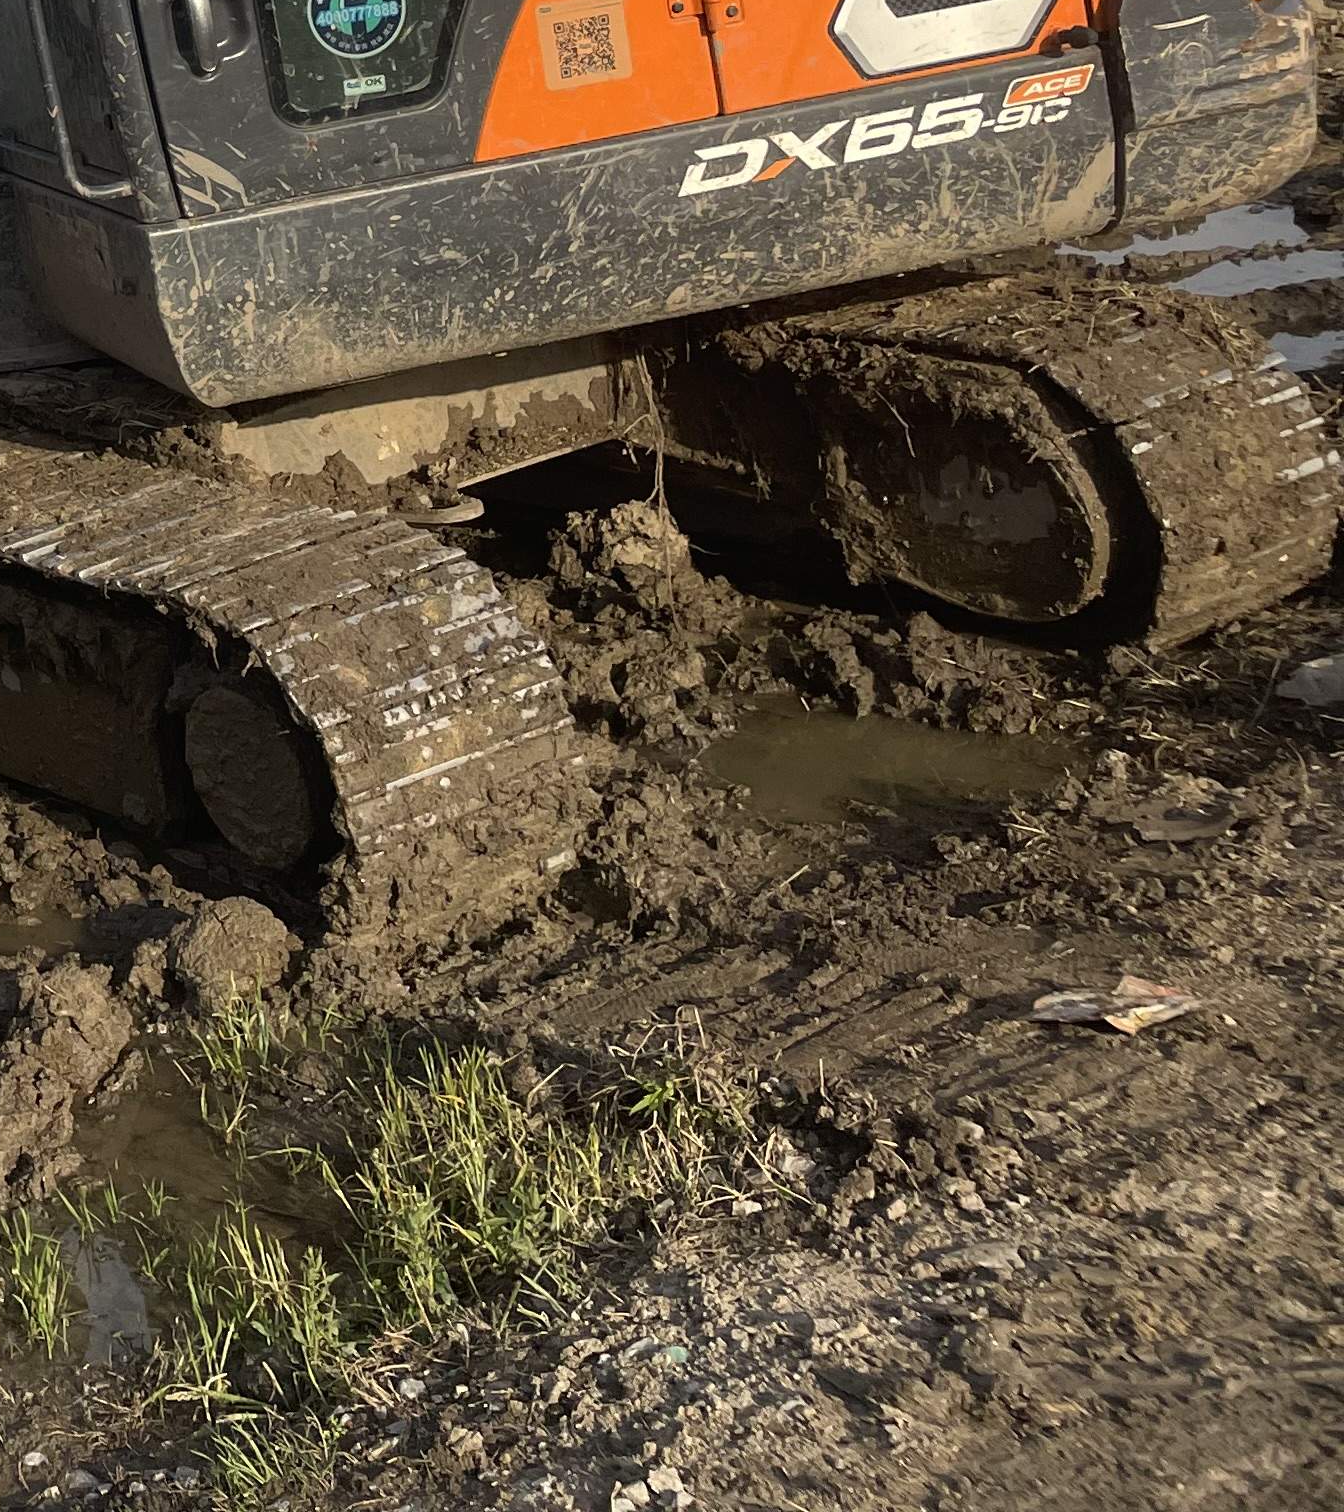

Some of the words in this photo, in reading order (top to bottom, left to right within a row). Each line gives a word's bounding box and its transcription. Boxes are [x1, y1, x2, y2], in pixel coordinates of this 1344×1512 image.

[315, 0, 399, 28] 4000777888
[365, 77, 383, 87] OK
[1023, 73, 1083, 97] ACE
